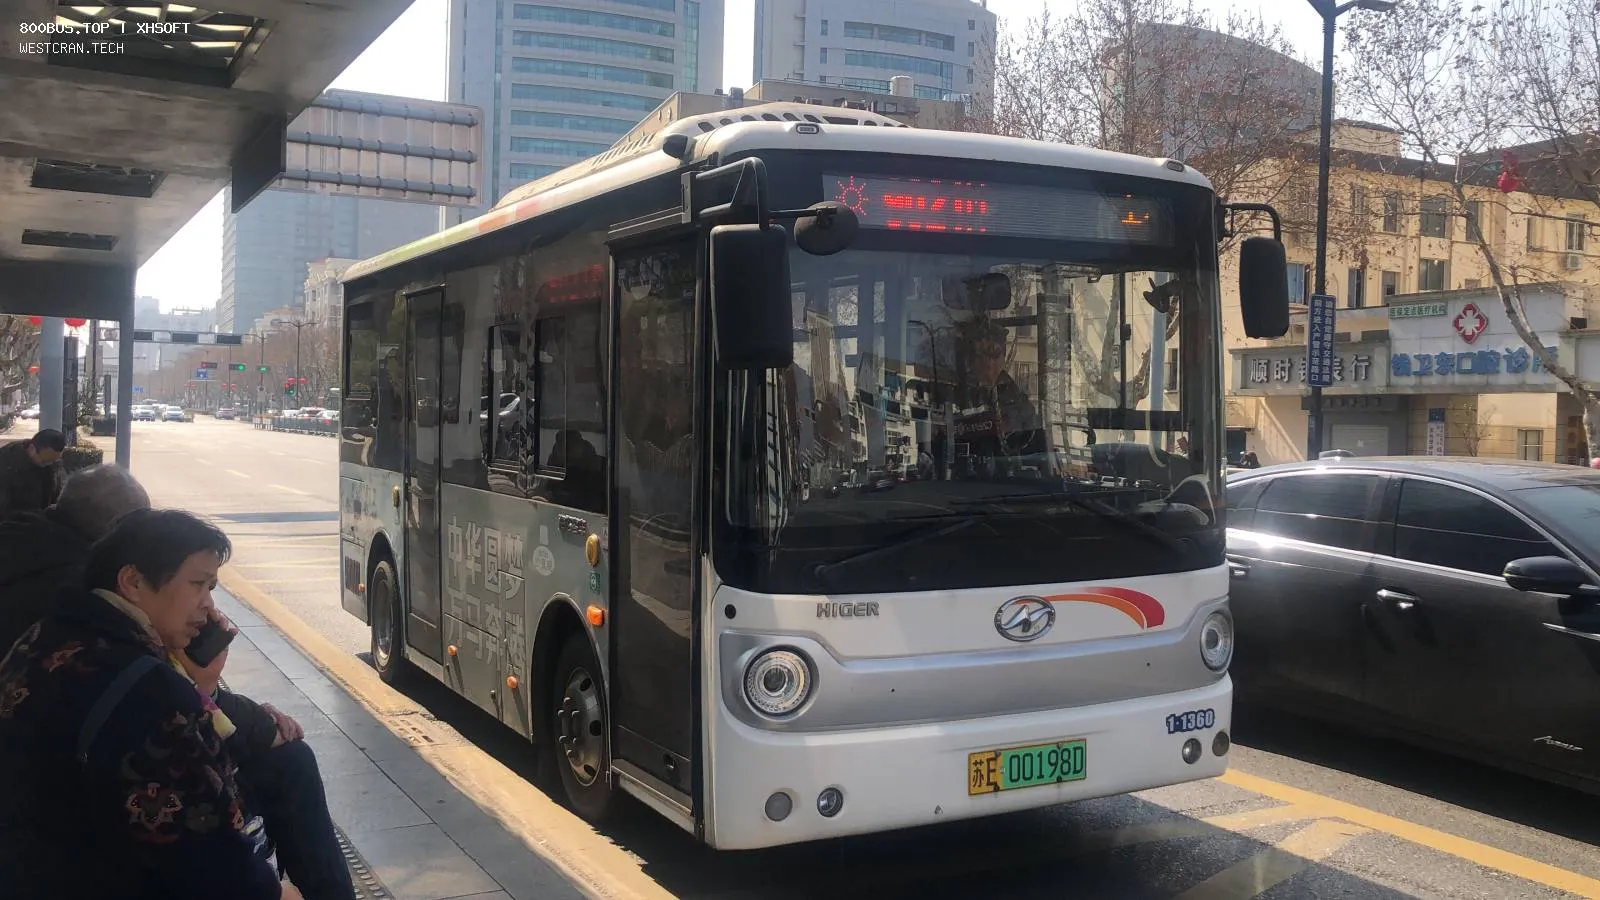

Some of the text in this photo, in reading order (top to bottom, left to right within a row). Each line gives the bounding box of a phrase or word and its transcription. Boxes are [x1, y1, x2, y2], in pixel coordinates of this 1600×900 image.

[816, 601, 880, 618] HIGER
[972, 746, 1084, 788] 苏E 00198D
